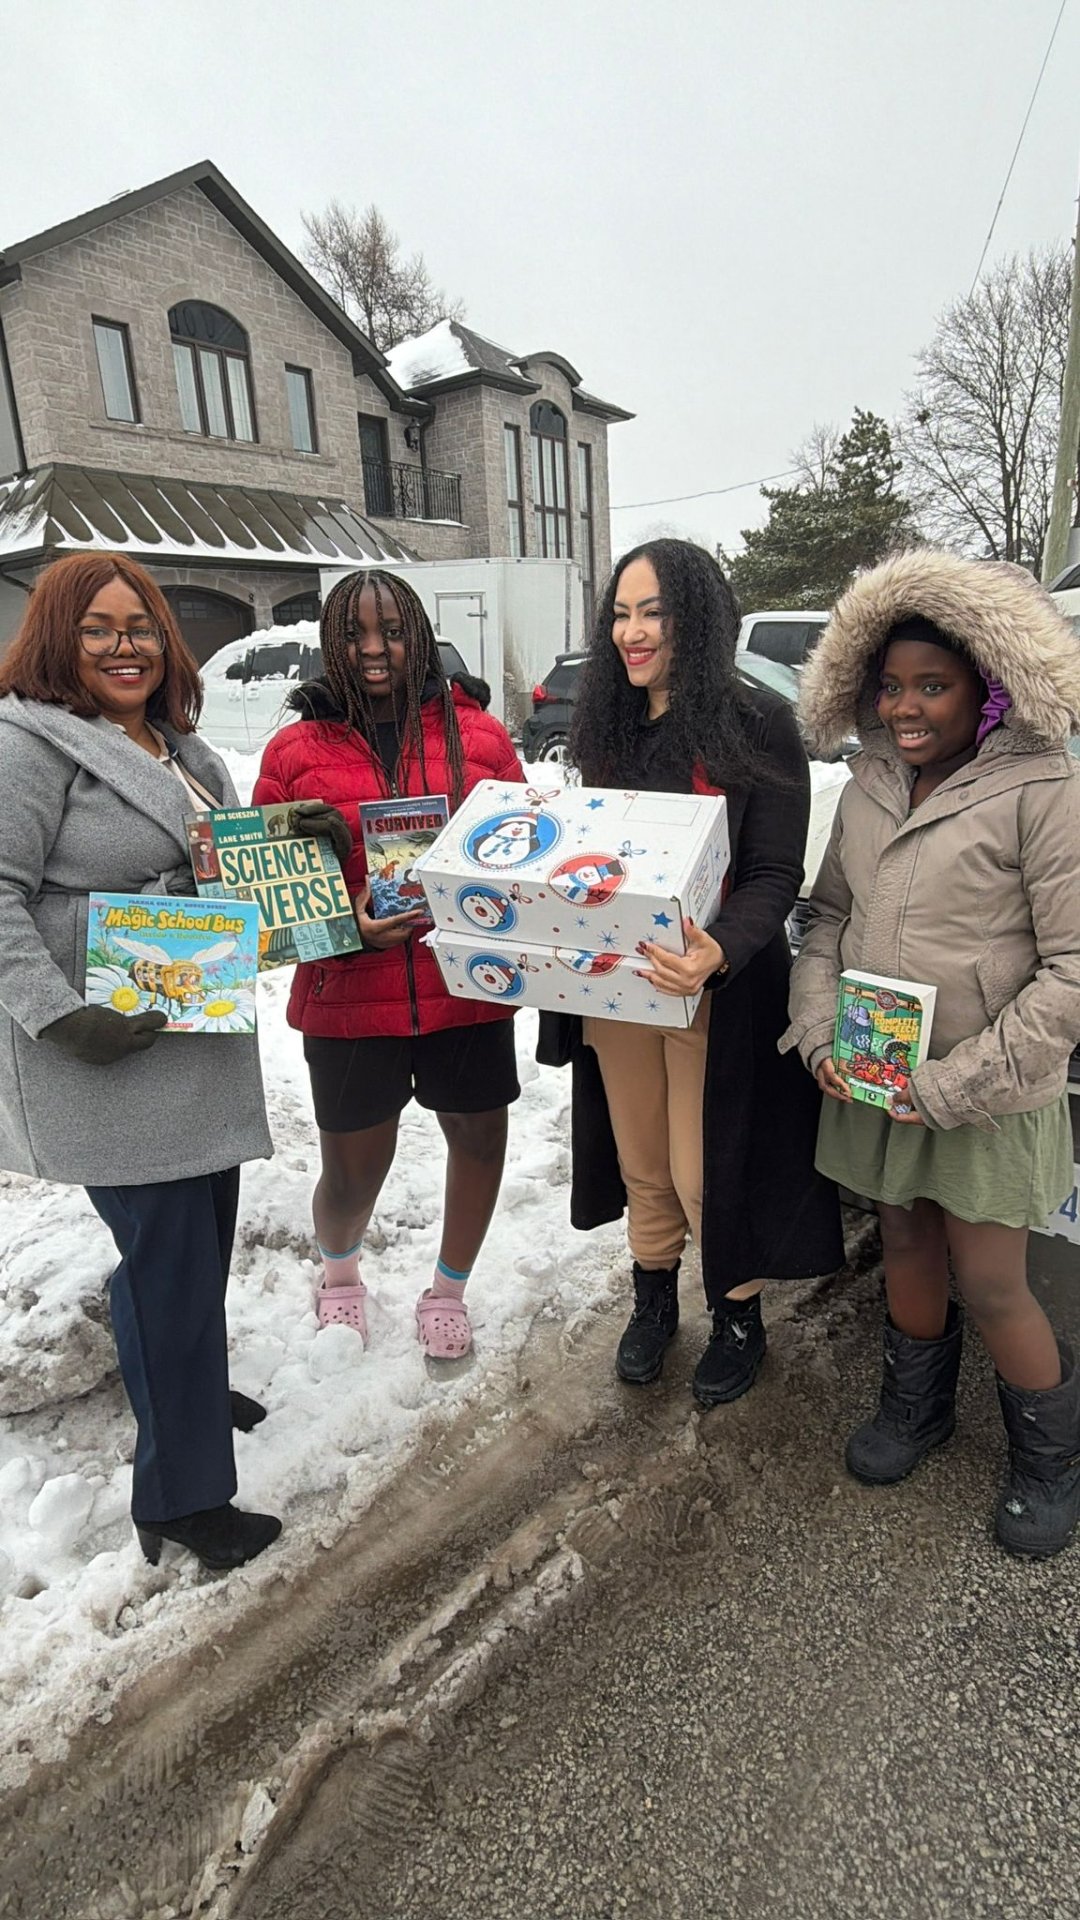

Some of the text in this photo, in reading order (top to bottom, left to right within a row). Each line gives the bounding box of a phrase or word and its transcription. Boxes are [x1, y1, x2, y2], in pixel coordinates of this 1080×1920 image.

[214, 810, 260, 821] JON SCIESZKA
[366, 814, 443, 834] I SURVIVED
[218, 832, 263, 844] LANE SMITH
[221, 840, 321, 886] SCIENCE
[129, 907, 148, 915] The
[254, 875, 351, 927] VERSE
[105, 907, 246, 934] Magic School Bus
